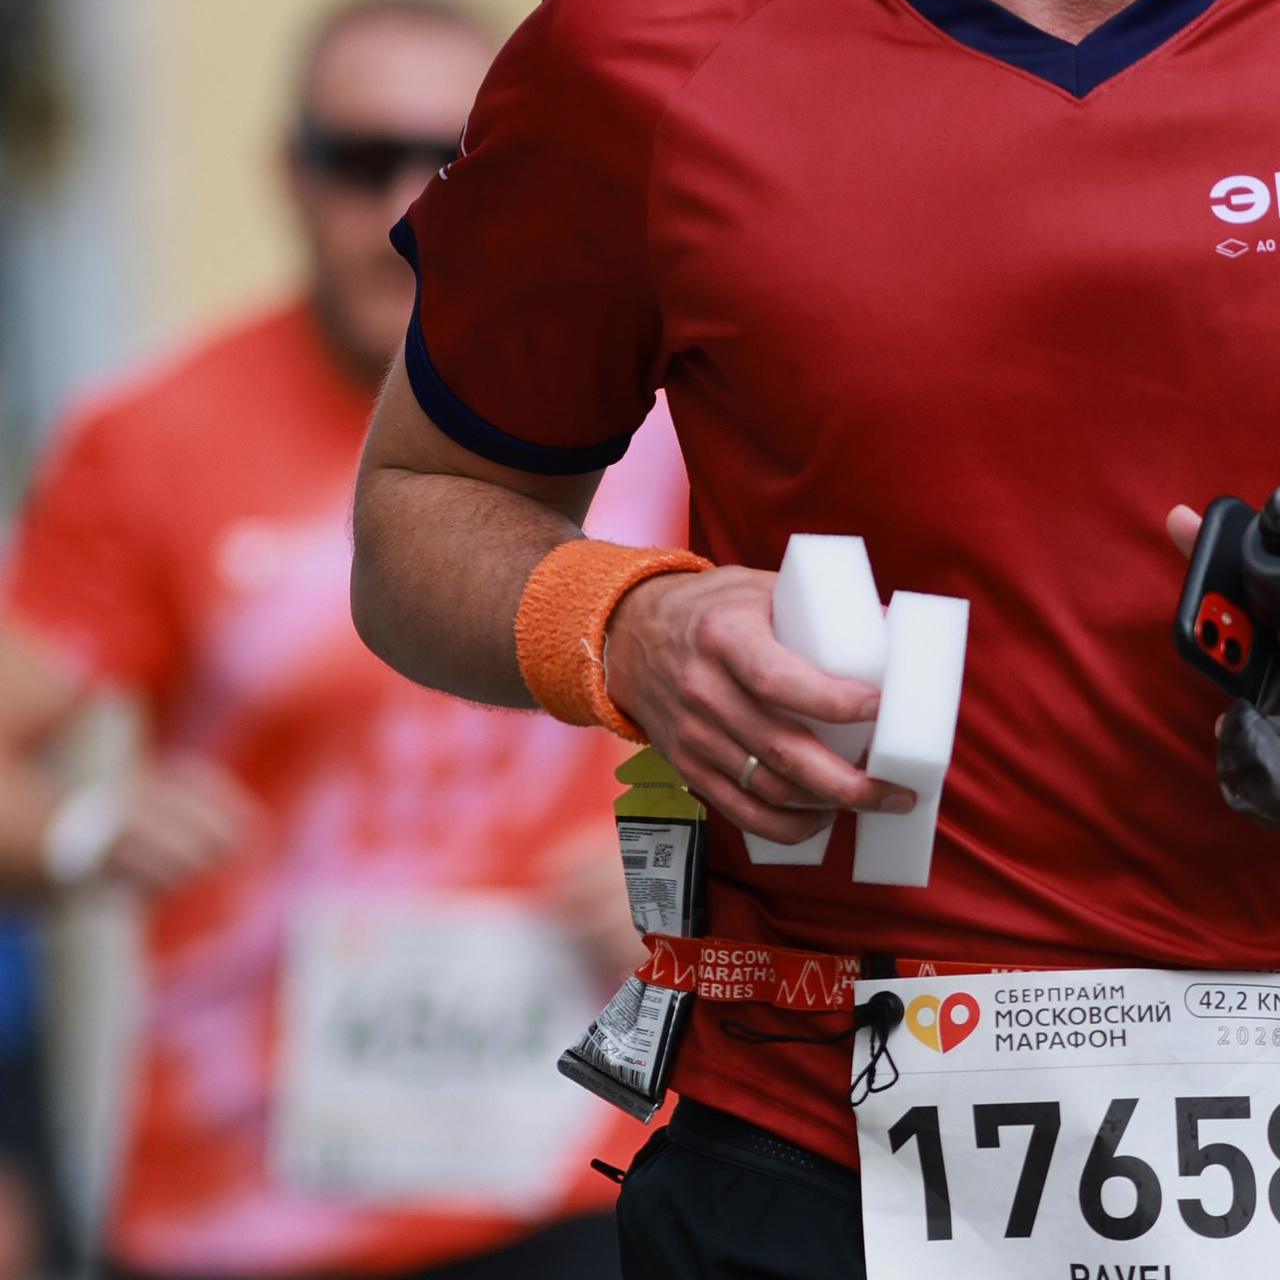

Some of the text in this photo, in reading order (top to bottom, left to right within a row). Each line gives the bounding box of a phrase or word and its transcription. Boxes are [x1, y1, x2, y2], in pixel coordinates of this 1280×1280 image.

[1256, 239, 1276, 252] АО
[994, 983, 1126, 1004] СБЕРПРАЙМ
[1199, 991, 1247, 1013] 42,2
[994, 1000, 1172, 1028] МОСКОВСКИЙ
[994, 1029, 1127, 1052] МАРАФОН
